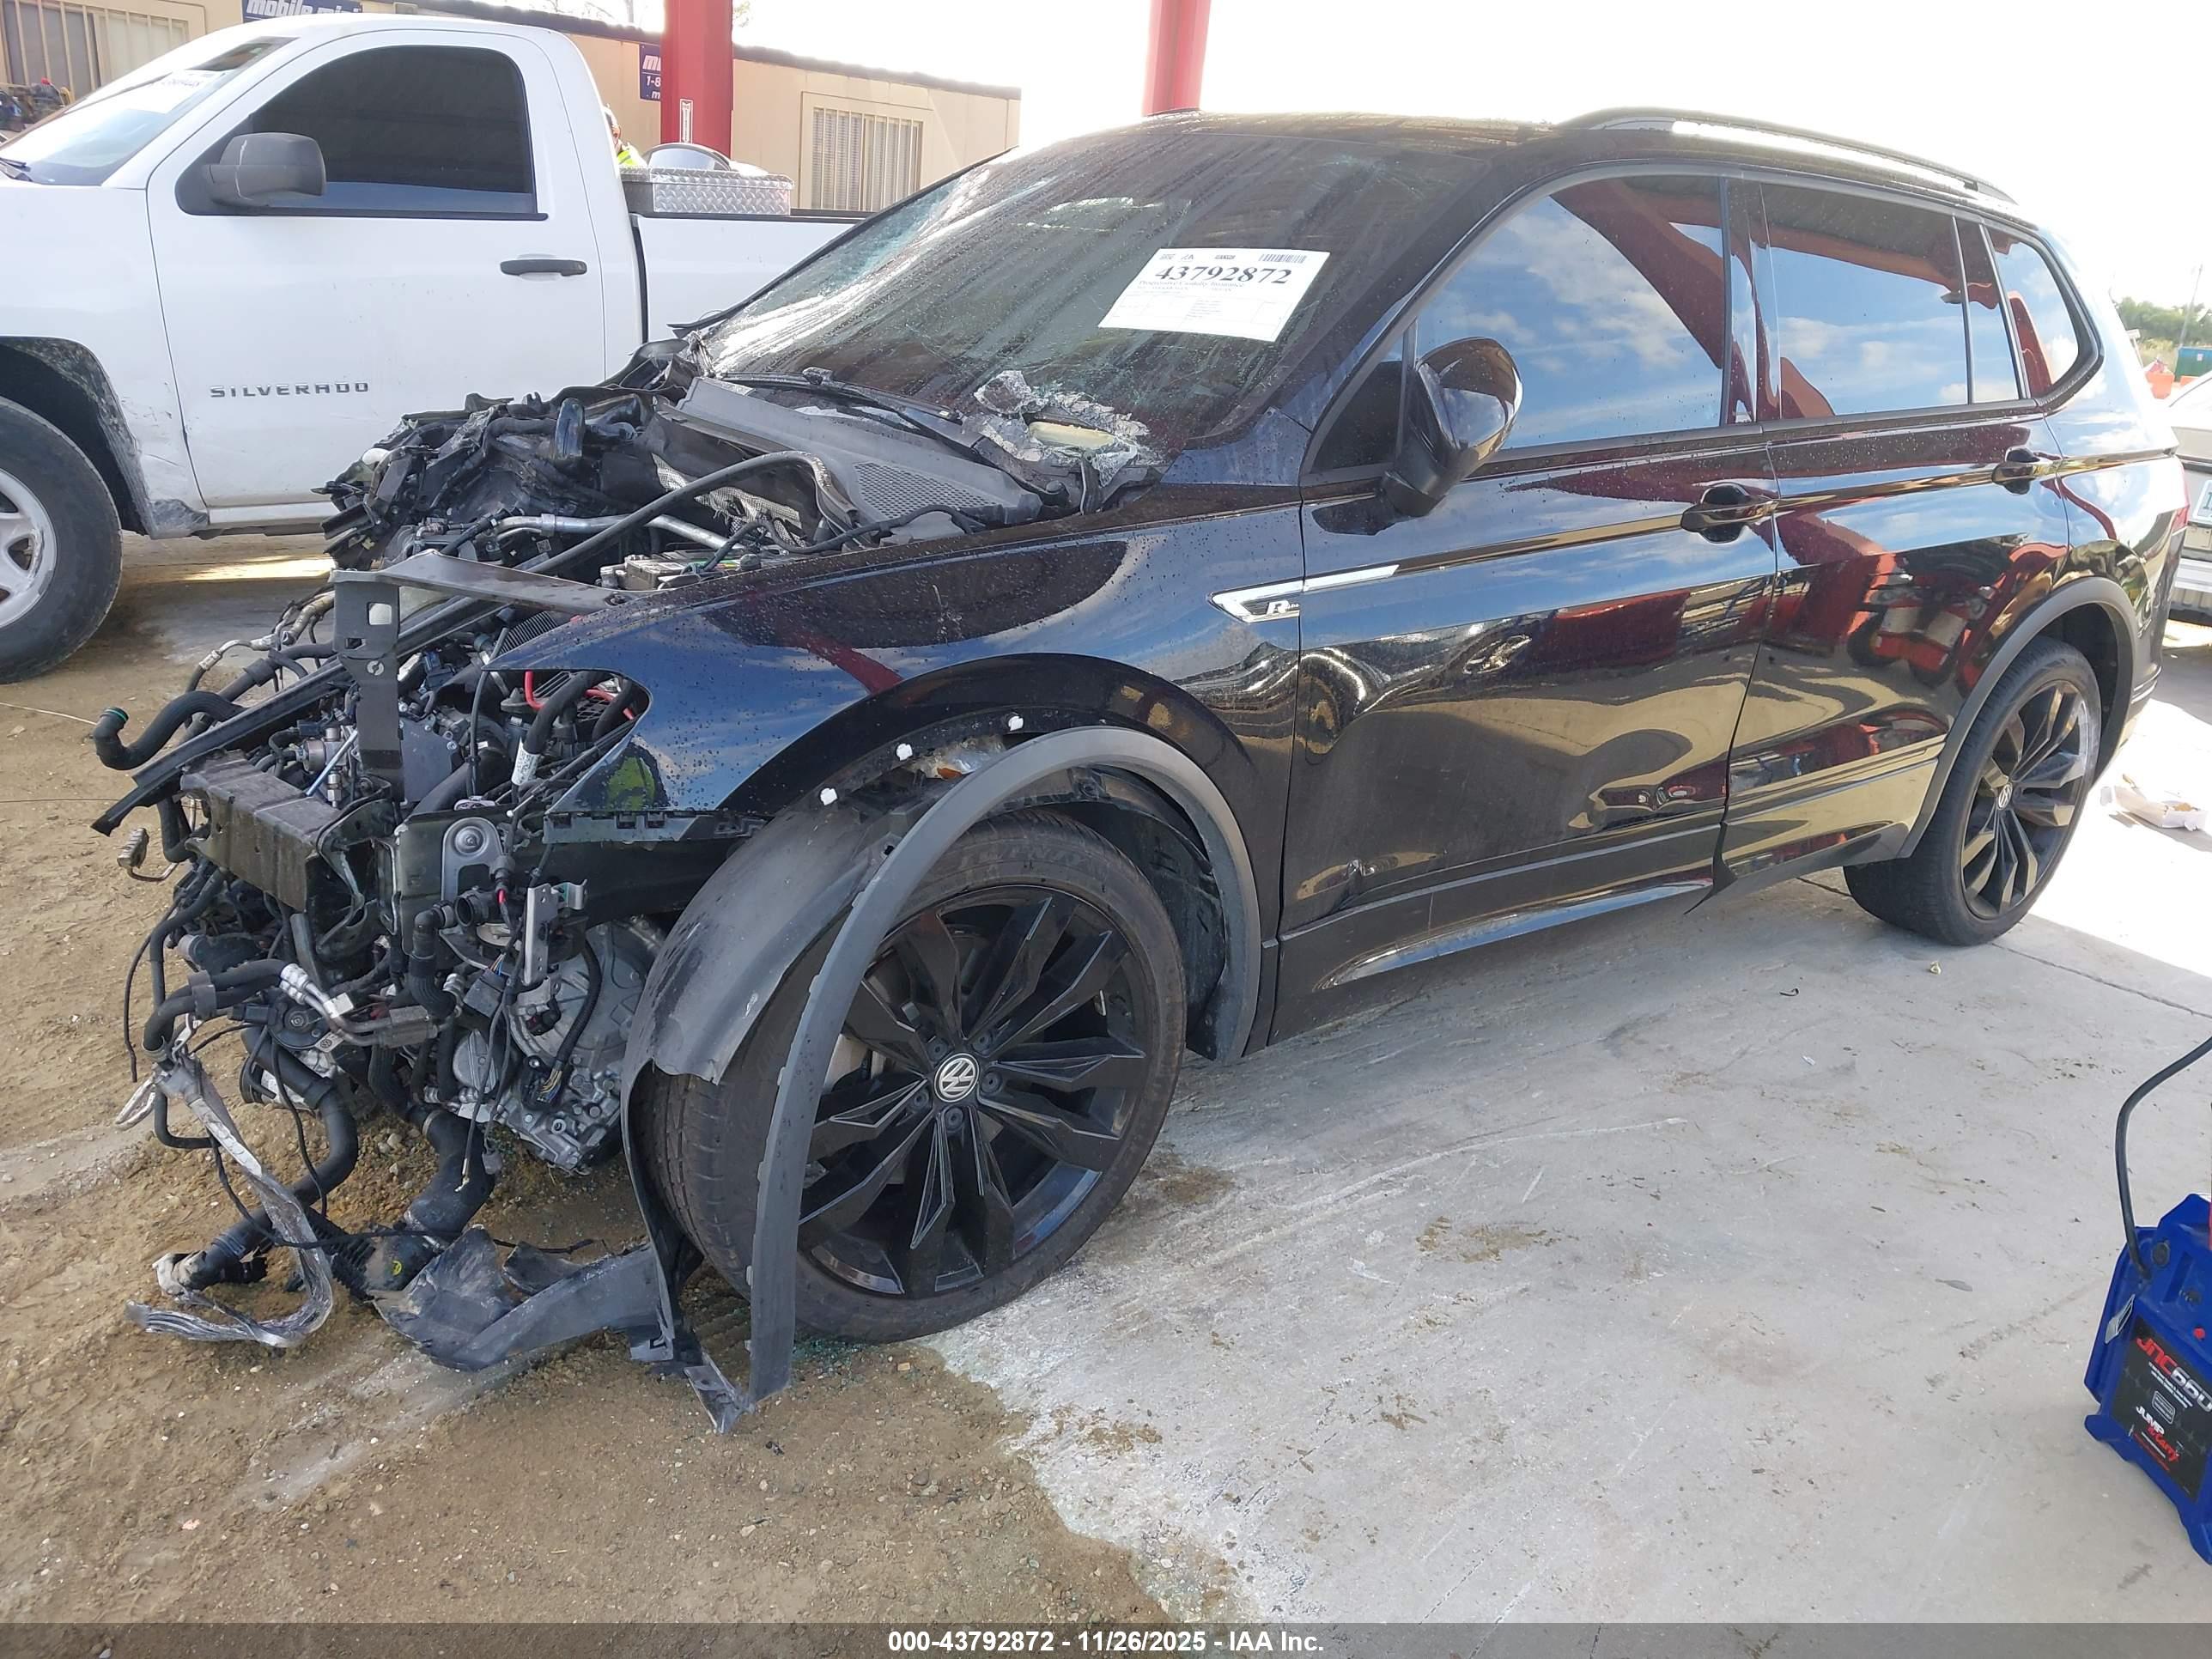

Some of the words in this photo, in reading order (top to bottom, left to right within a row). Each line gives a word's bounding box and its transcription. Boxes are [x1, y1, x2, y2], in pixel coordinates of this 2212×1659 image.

[1155, 264, 1291, 284] 43792872
[210, 382, 369, 398] SILVERADO
[2136, 1406, 2165, 1435] JUMP
